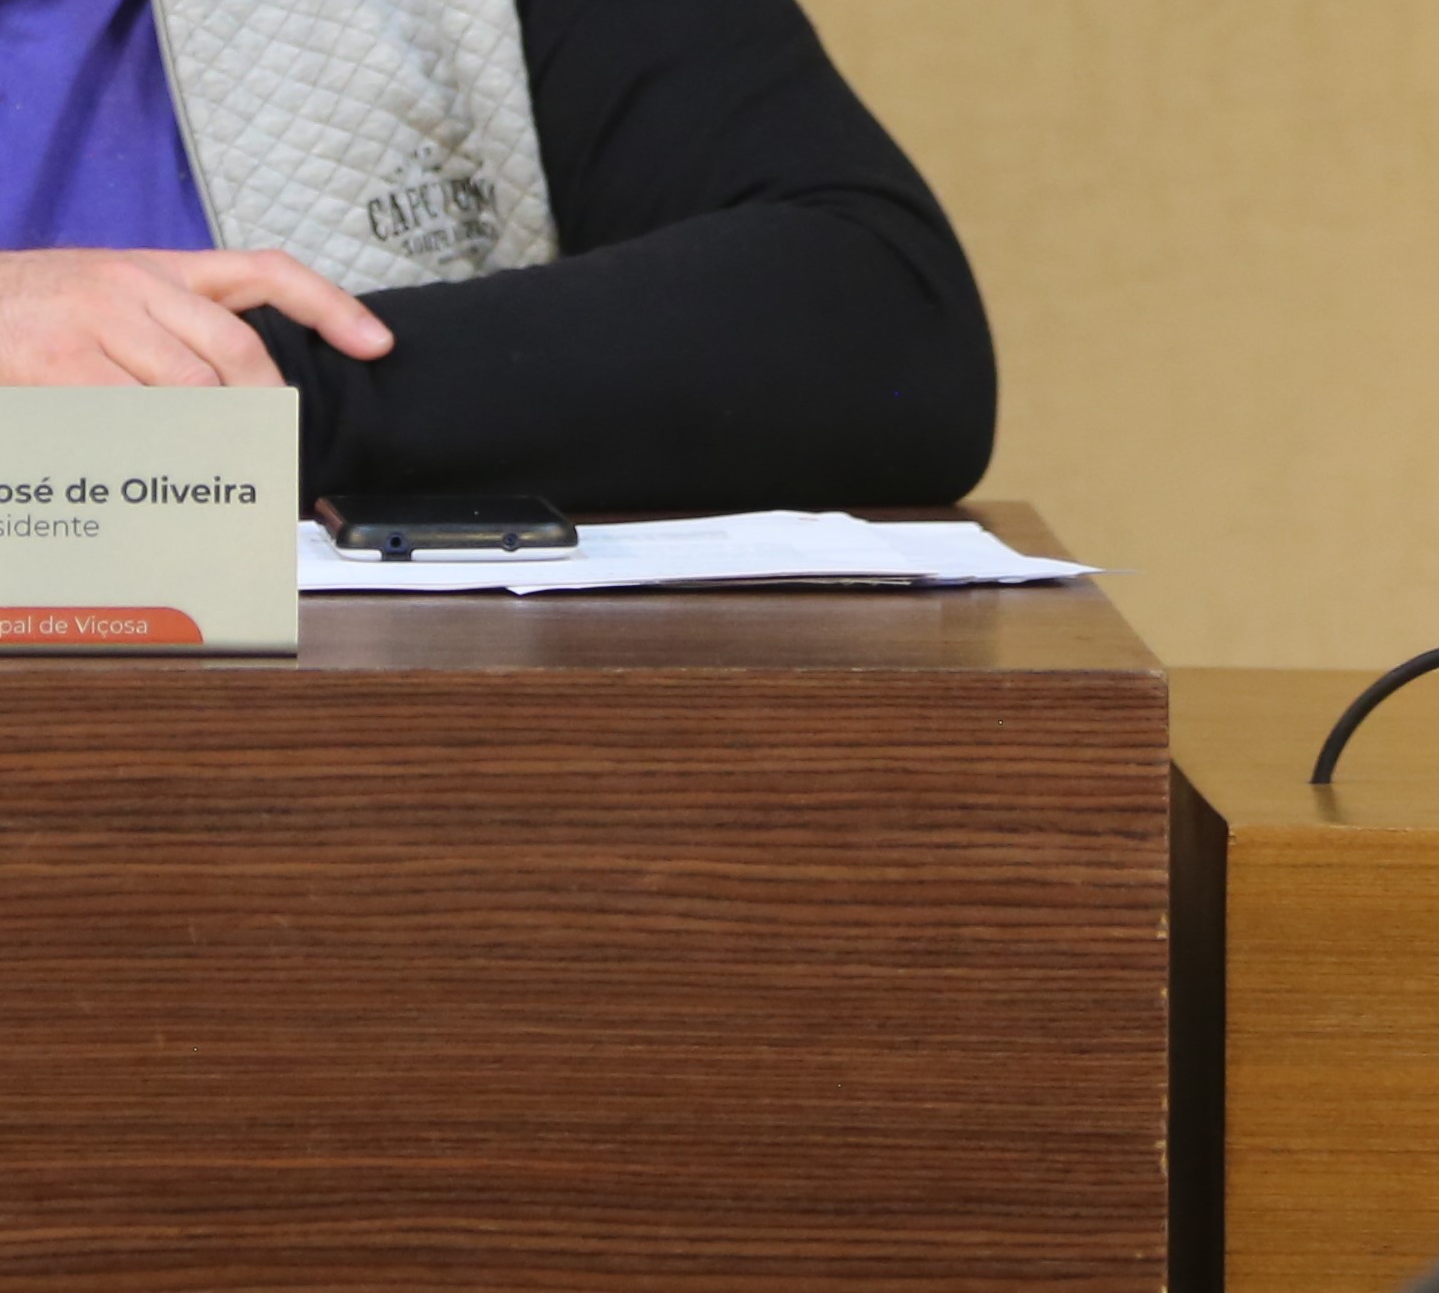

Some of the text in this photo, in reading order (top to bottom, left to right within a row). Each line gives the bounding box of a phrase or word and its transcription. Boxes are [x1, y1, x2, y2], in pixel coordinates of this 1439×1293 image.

[65, 477, 110, 504] de
[121, 475, 257, 504] Oliveira
[39, 616, 69, 635] de
[74, 616, 148, 638] Viçosa
